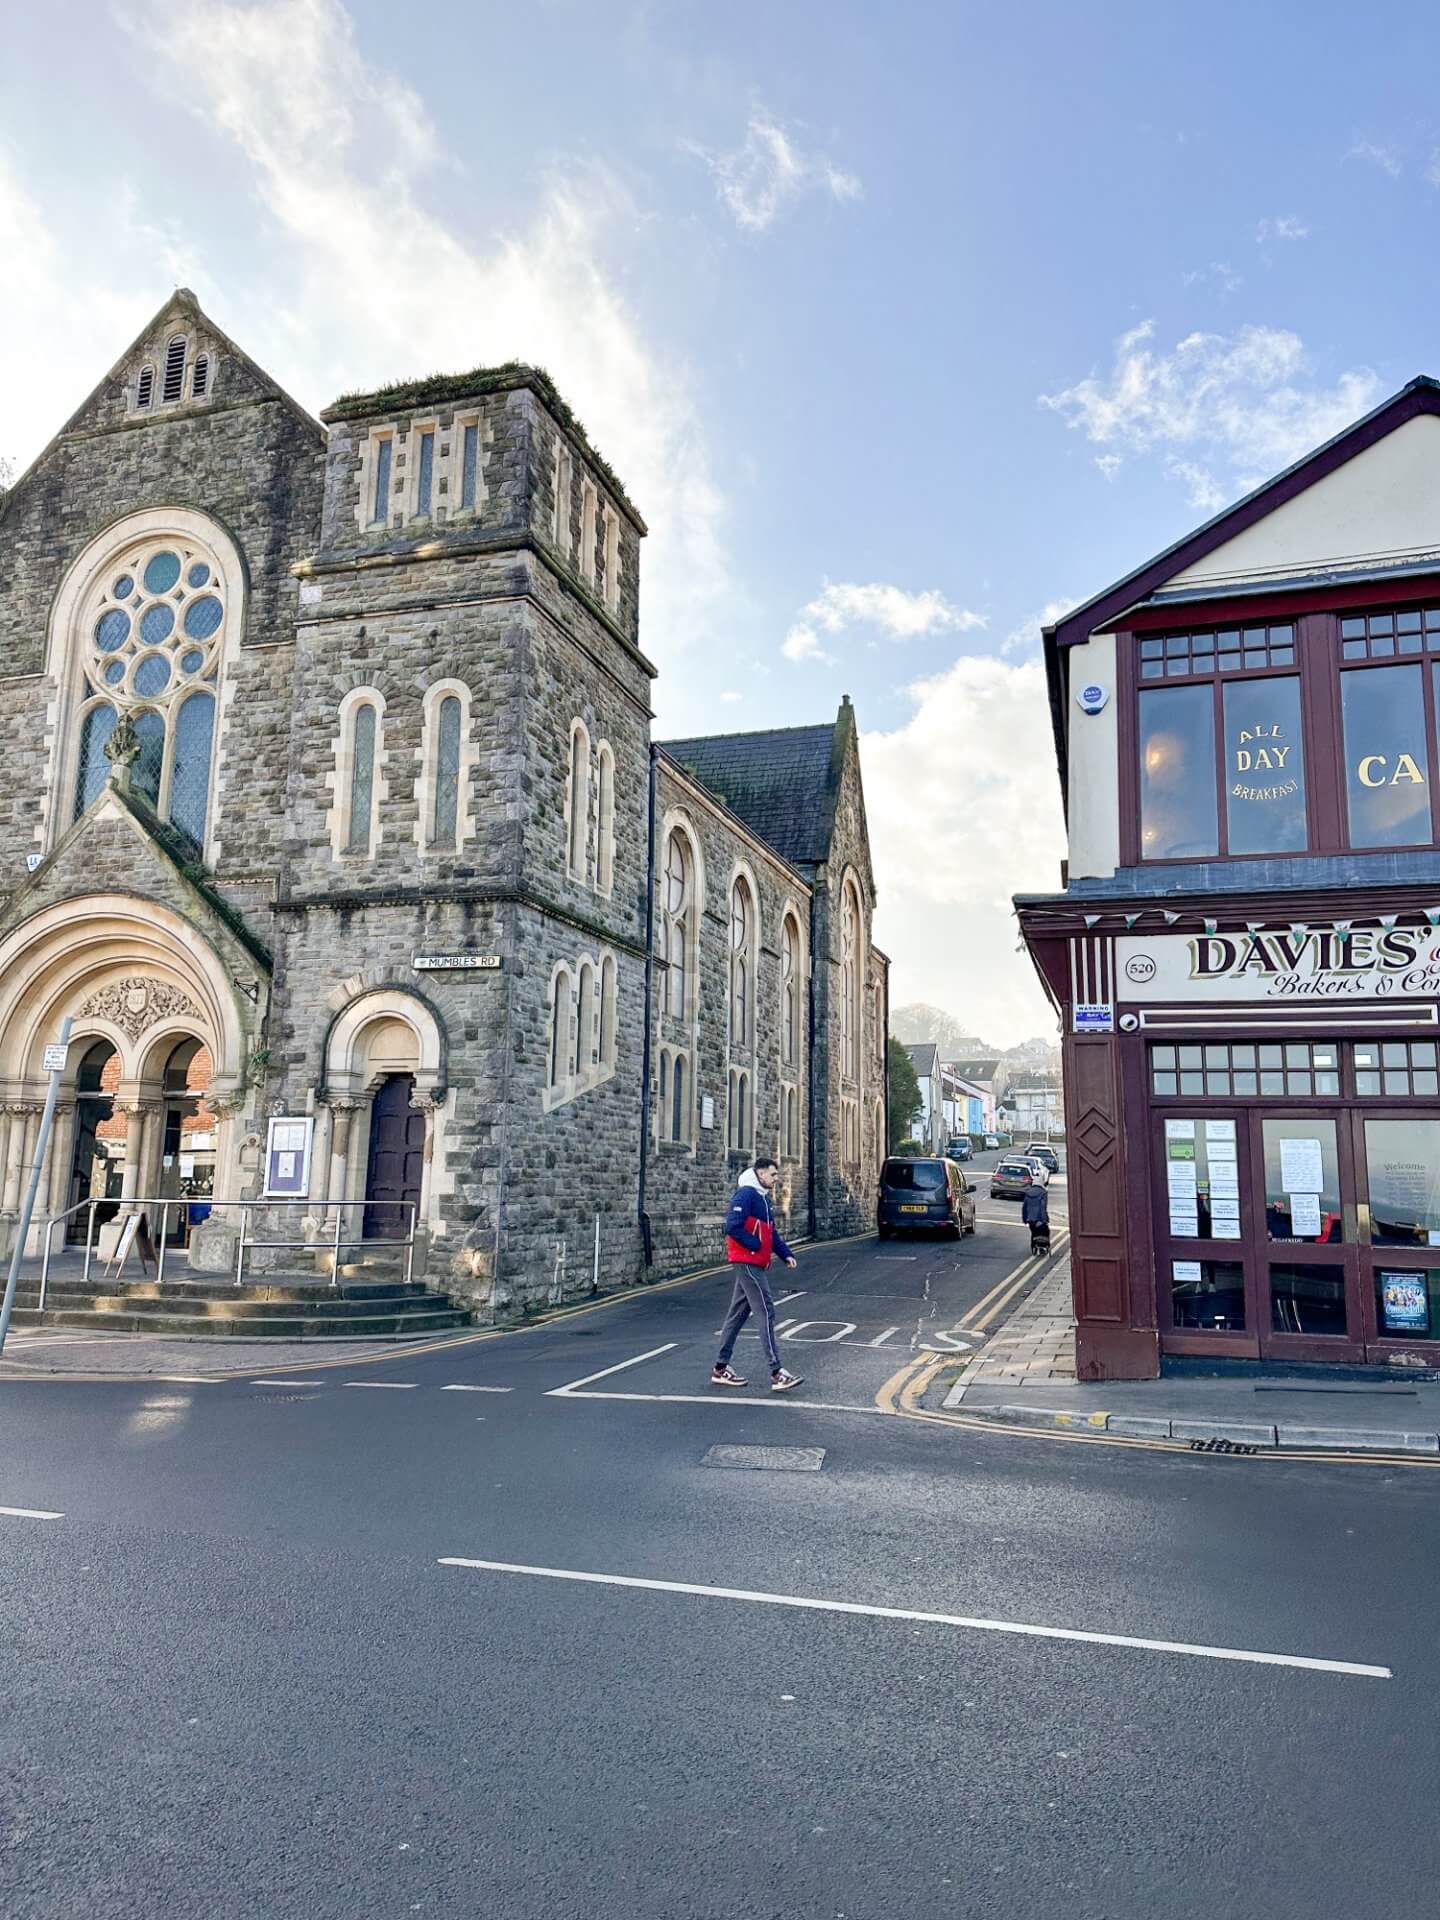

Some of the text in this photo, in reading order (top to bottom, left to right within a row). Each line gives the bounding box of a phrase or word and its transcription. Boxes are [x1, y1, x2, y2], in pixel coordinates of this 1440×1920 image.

[1239, 725, 1286, 745] ALL
[1236, 746, 1290, 772] DAY
[1358, 754, 1425, 788] CA
[1231, 780, 1299, 800] BREAKFAST
[428, 957, 495, 967] MUMBLES RD
[1189, 926, 1432, 979] DAVIES'
[1129, 963, 1153, 974] 520
[1267, 971, 1365, 996] Bakers
[1375, 974, 1394, 996] &
